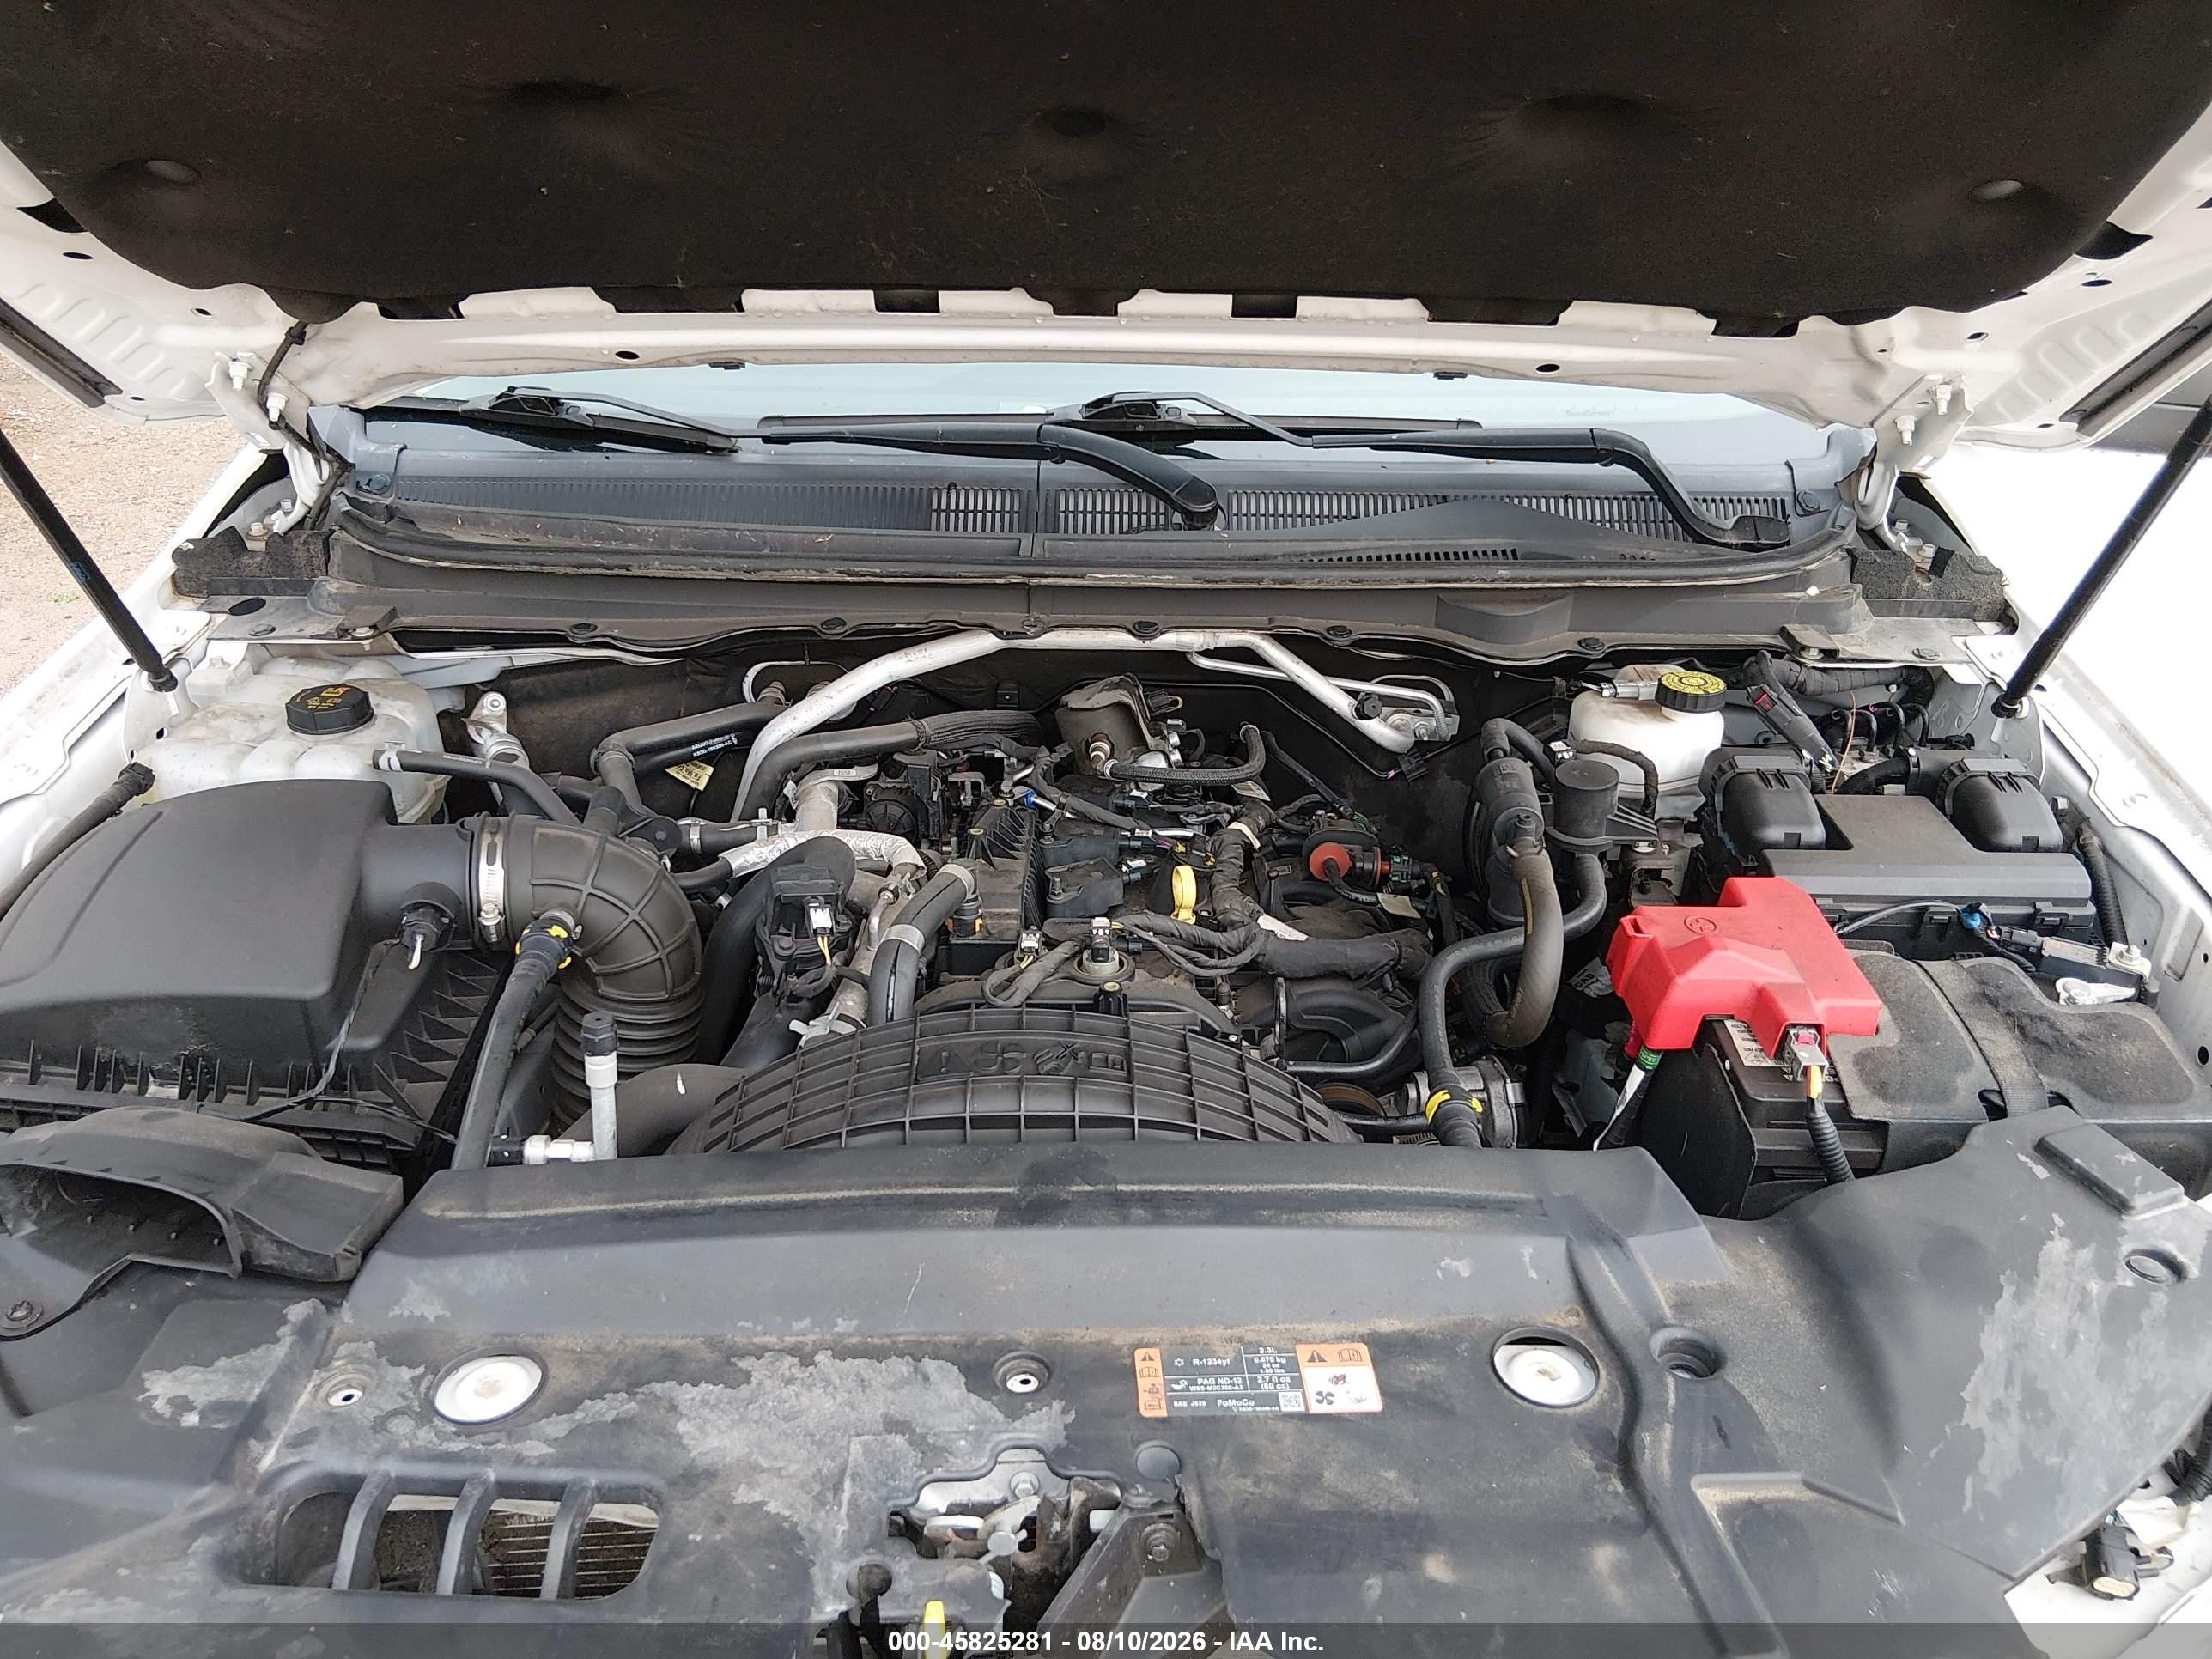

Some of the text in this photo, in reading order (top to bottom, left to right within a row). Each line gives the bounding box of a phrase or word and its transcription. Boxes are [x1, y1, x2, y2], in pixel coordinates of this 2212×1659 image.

[1192, 1358, 1231, 1367] R-1234yf
[1197, 1376, 1243, 1386] PAG ND-12
[1217, 1398, 1255, 1407] FoMoCo
